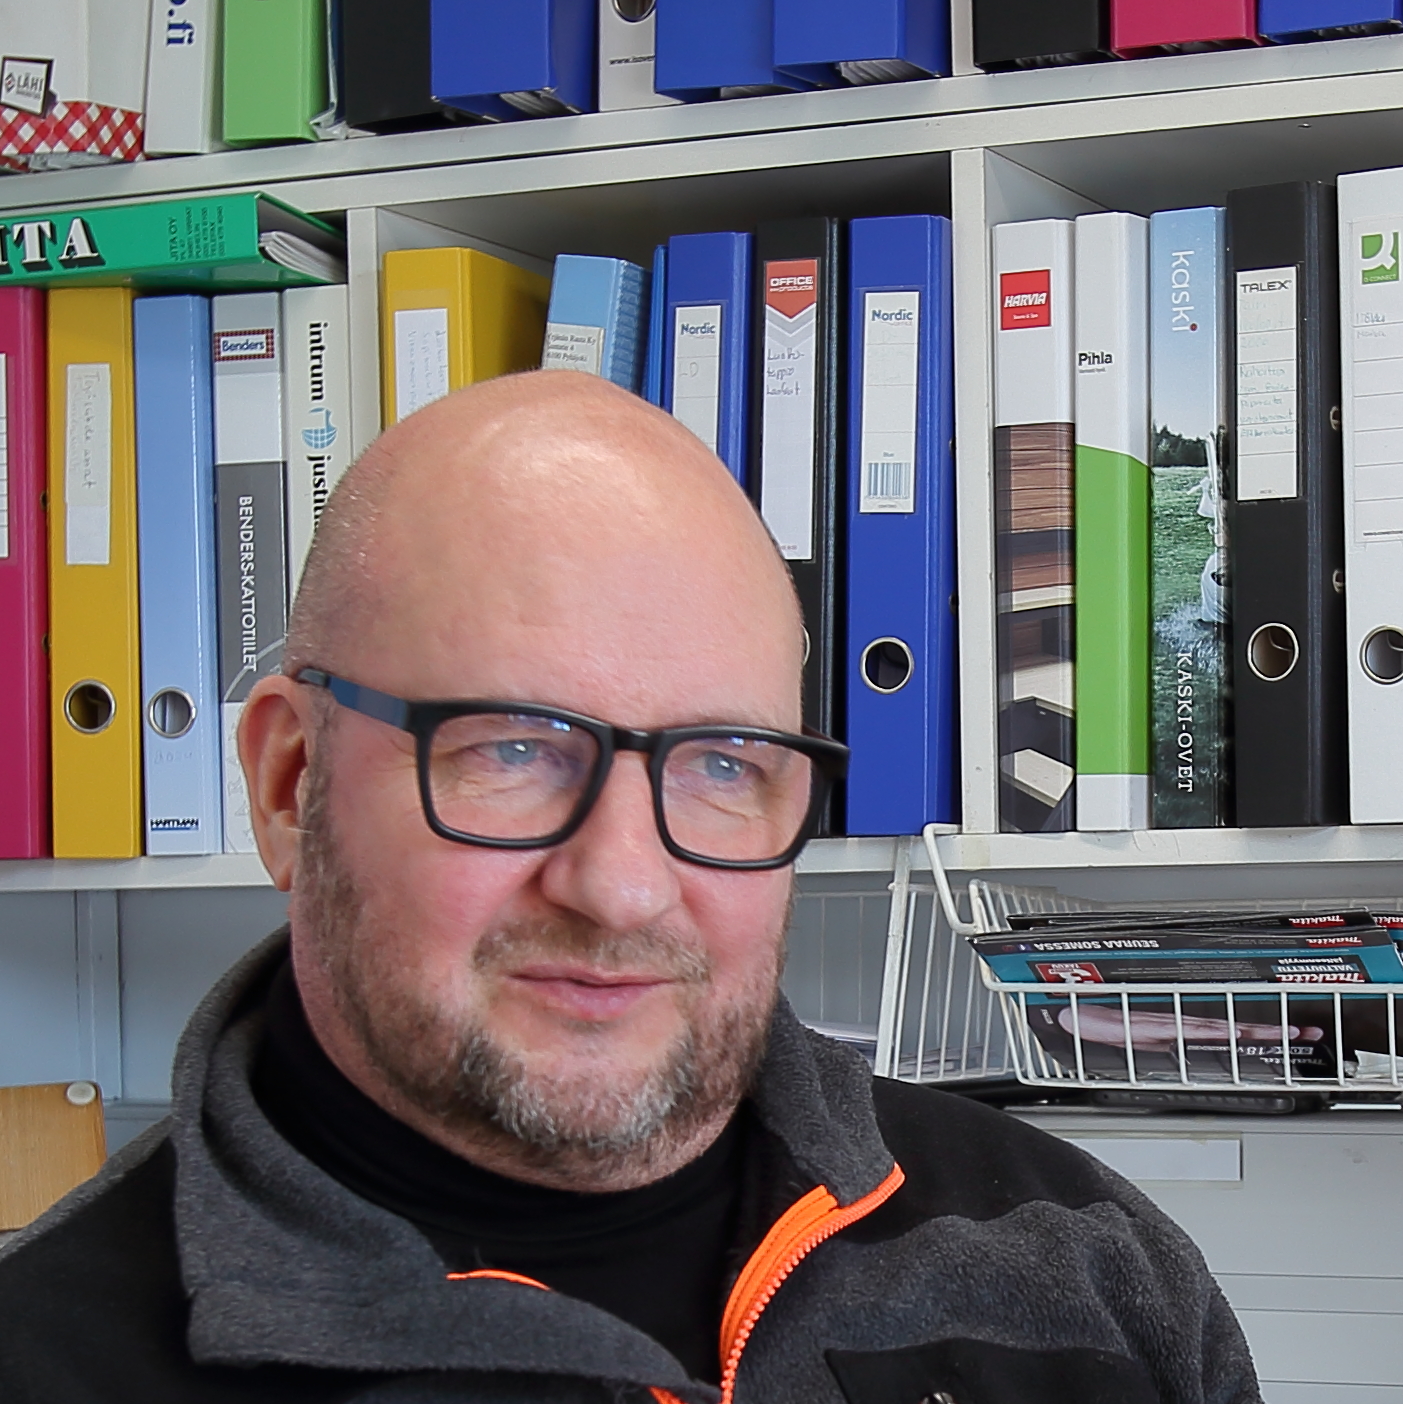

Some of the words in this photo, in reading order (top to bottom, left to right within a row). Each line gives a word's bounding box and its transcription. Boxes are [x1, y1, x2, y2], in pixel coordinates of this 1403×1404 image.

[167, 0, 194, 45] .fi
[17, 73, 43, 92] LÄHI
[168, 236, 178, 261] JITA
[770, 276, 813, 287] OFFICE
[1240, 280, 1289, 294] TALEX
[1171, 250, 1198, 332] kaski
[1003, 292, 1047, 308] HARVIA
[872, 309, 913, 322] Nordic
[680, 322, 716, 336] Nordic
[222, 339, 265, 352] Benders
[309, 322, 329, 401] intrum
[1078, 351, 1113, 366] Pihla
[239, 496, 257, 672] BENDERS-KATTOTIILET
[1176, 651, 1195, 793] KASKI-OVET
[1289, 914, 1345, 926] makita
[1033, 942, 1102, 951] SOMESSA
[1103, 939, 1160, 949] SEURAA
[1305, 936, 1363, 947] makita
[1276, 964, 1354, 973] VALTUUTETTU
